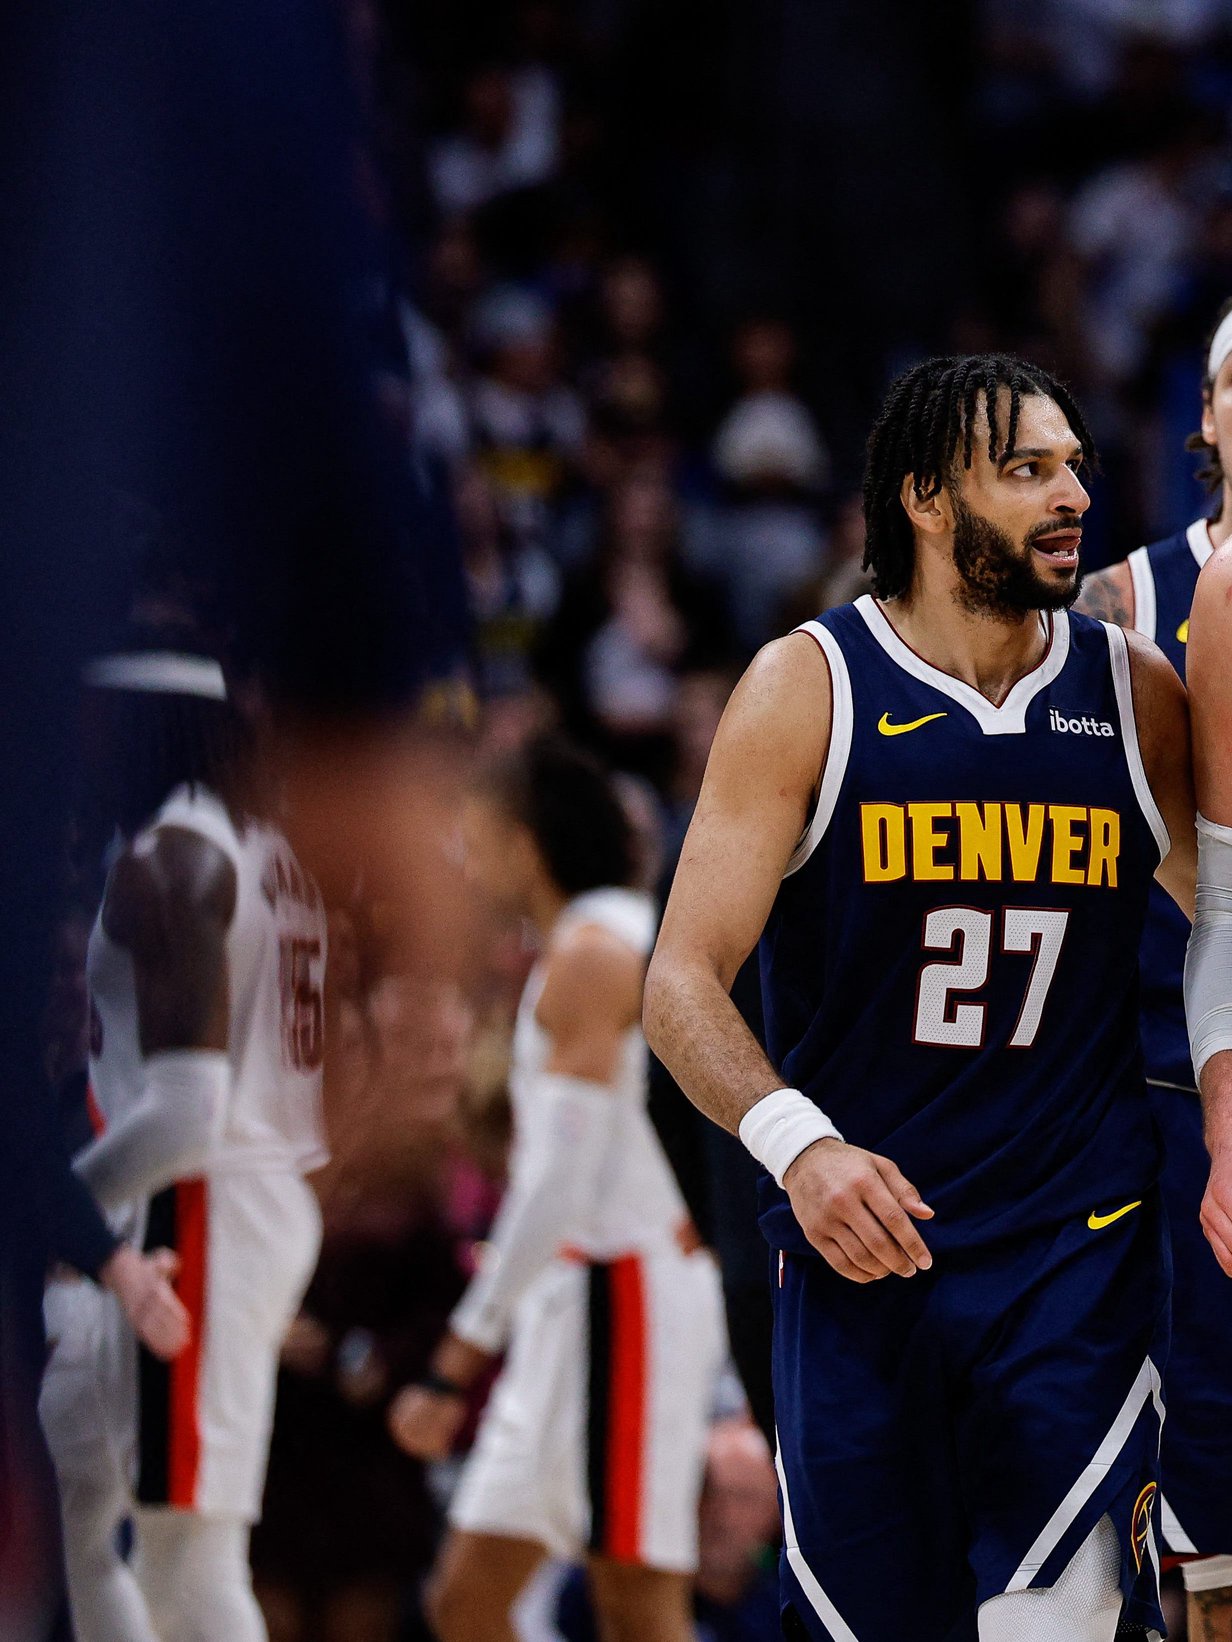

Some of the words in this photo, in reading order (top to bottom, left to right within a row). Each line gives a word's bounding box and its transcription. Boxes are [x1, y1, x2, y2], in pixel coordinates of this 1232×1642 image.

[1049, 709, 1115, 737] ibotta
[859, 801, 1121, 888] DENVER
[912, 904, 1072, 1049] 27
